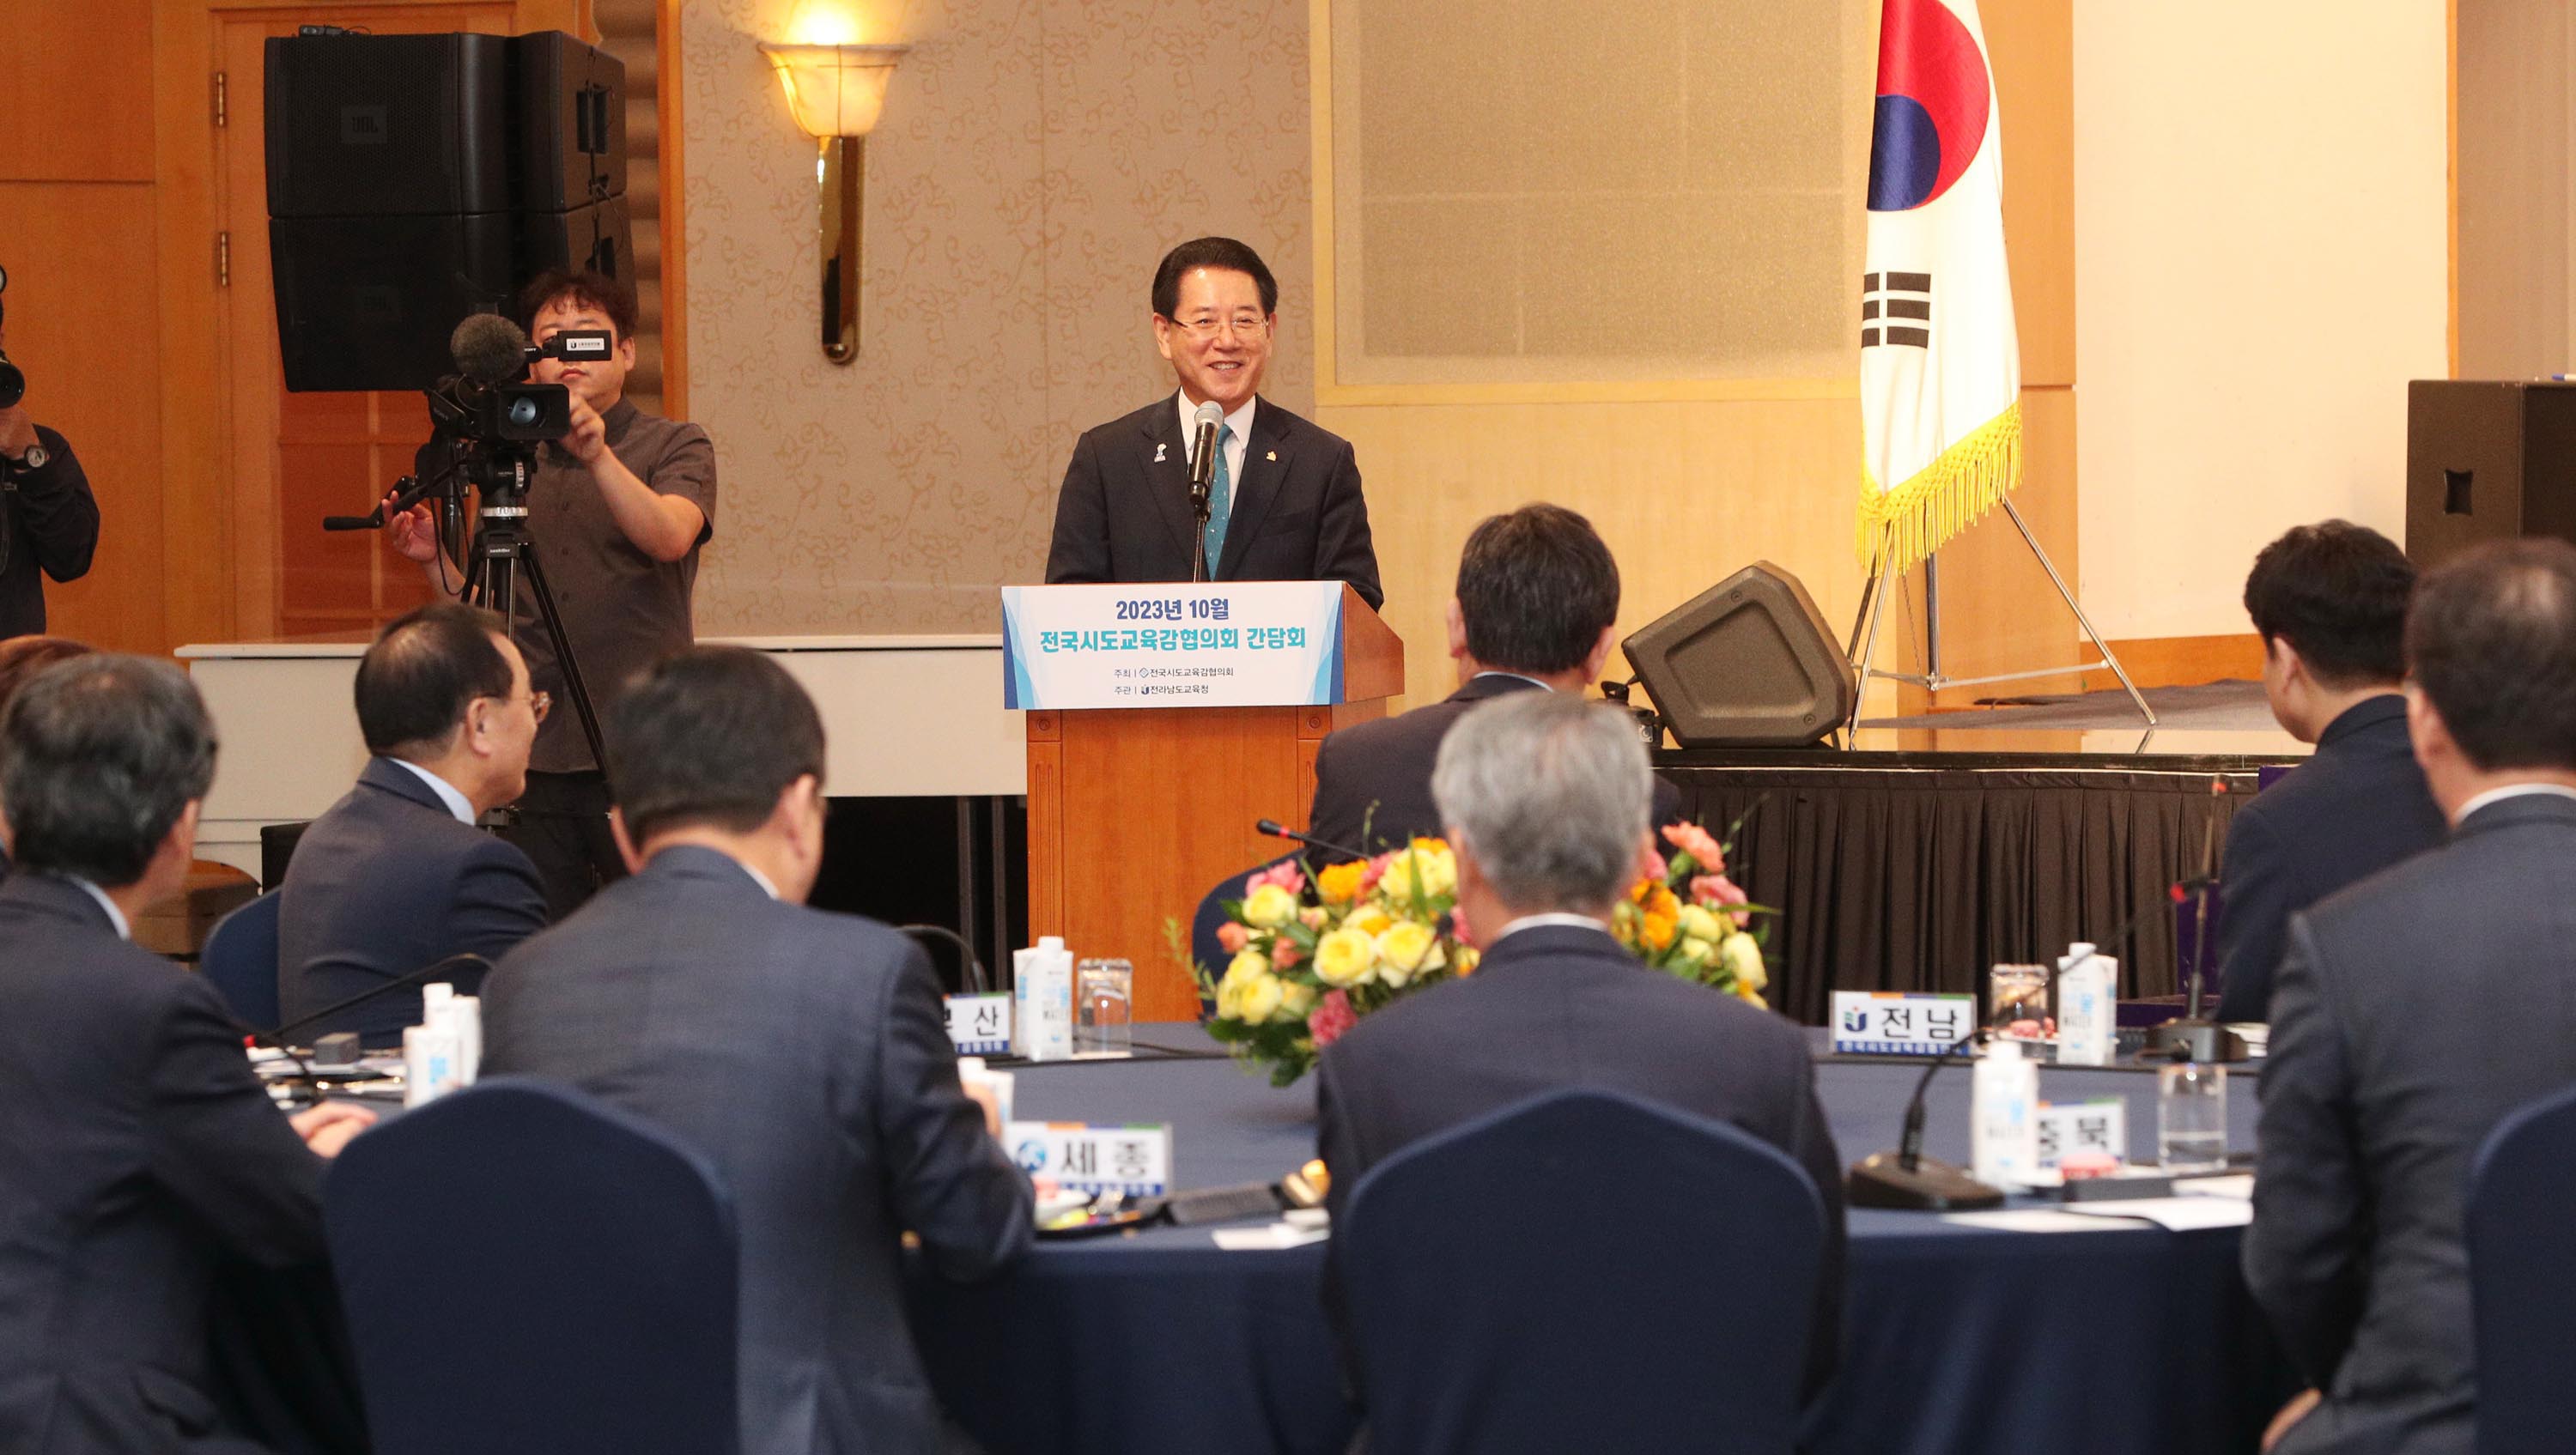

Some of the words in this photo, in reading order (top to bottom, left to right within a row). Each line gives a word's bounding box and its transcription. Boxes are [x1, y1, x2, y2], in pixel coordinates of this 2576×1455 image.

[1116, 599, 1182, 621] 2023년
[1188, 598, 1230, 621] 10월
[1040, 627, 1239, 652] 전국시도교육감협의회
[1246, 627, 1306, 649] 간담회
[1114, 669, 1131, 678] 주최
[1150, 667, 1234, 678] 전국시도교육감협의회
[1114, 686, 1131, 695] 주관
[1150, 684, 1209, 694] 전라남도교육청
[1881, 1007, 1959, 1040] 전남
[1060, 1142, 1148, 1177] 세종
